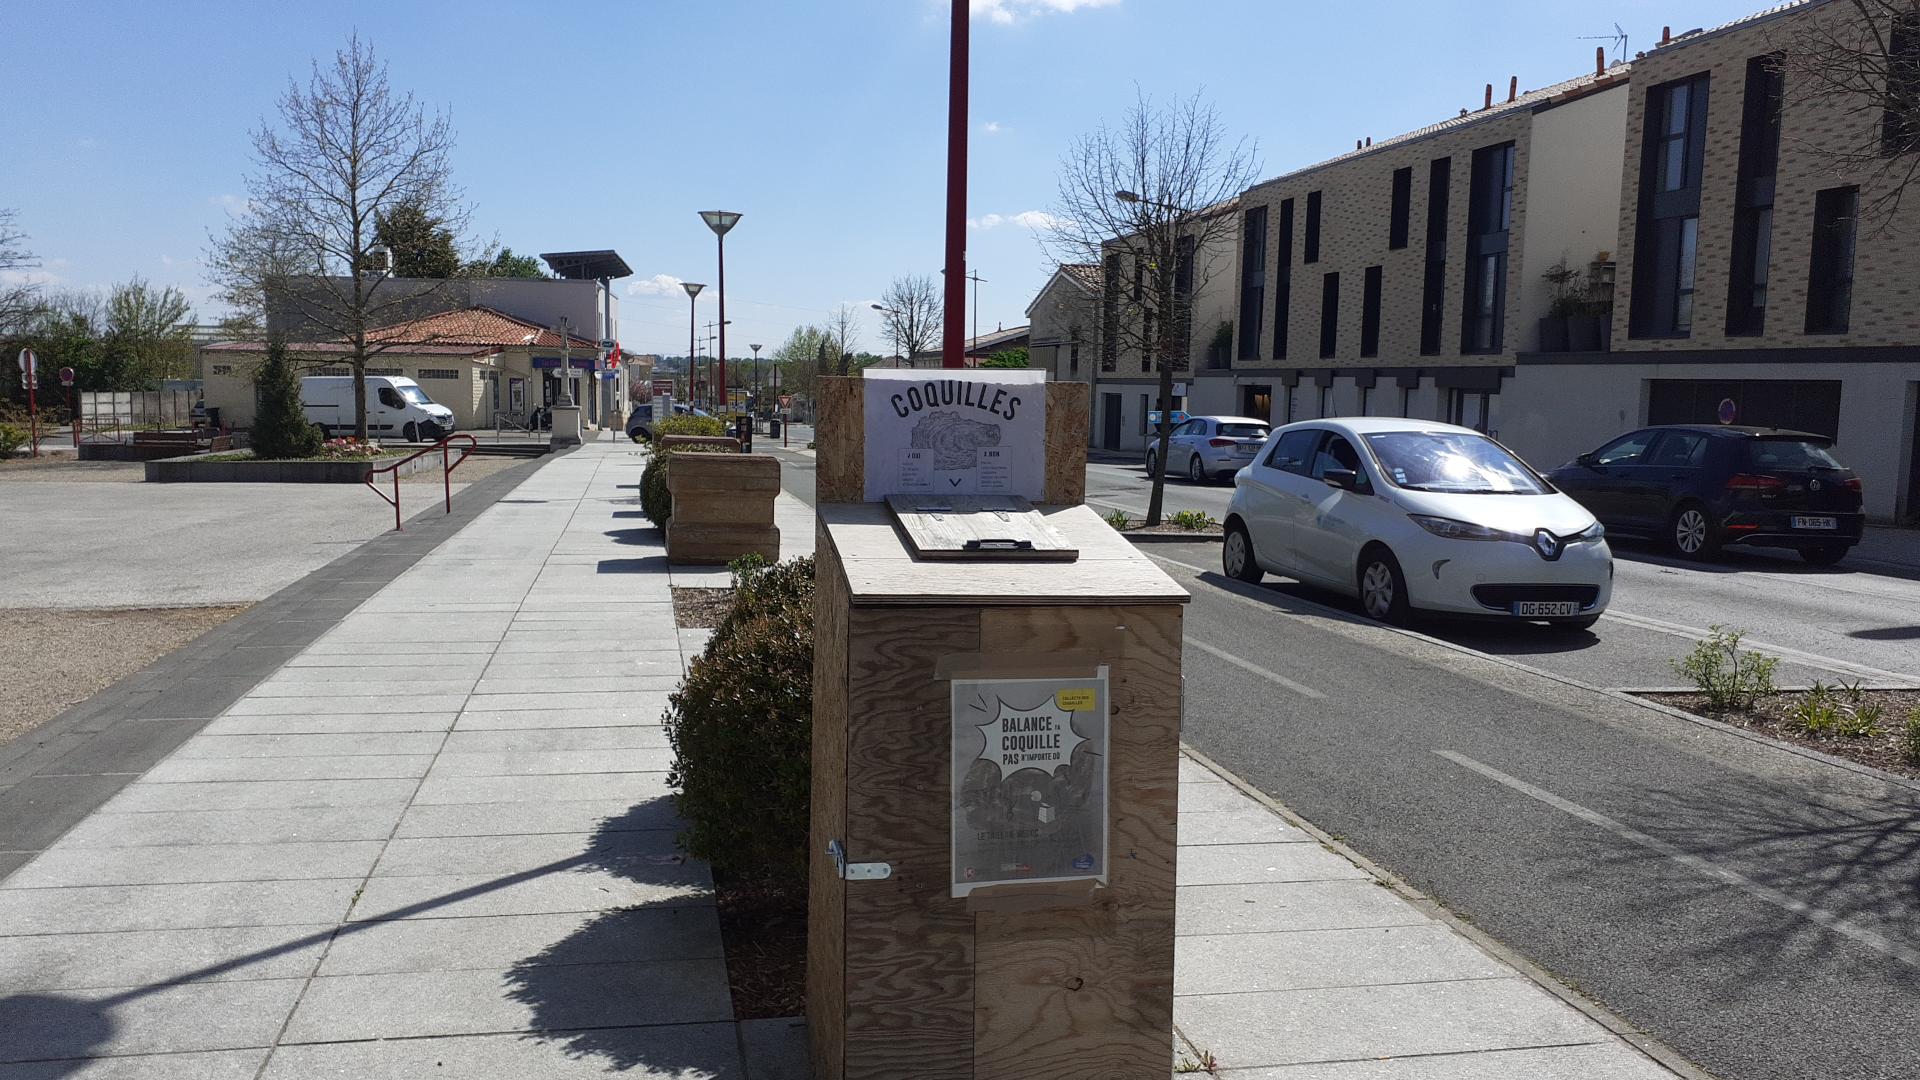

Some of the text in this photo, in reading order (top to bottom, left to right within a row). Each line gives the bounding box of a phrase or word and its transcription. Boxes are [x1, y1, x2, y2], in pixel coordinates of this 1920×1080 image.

[890, 379, 1022, 421] COQUILLES
[1002, 716, 1053, 733] BALANCE
[1002, 734, 1061, 752] COQUILLE
[1002, 753, 1019, 765] PAS
[1021, 753, 1052, 761] N'IMPORTE
